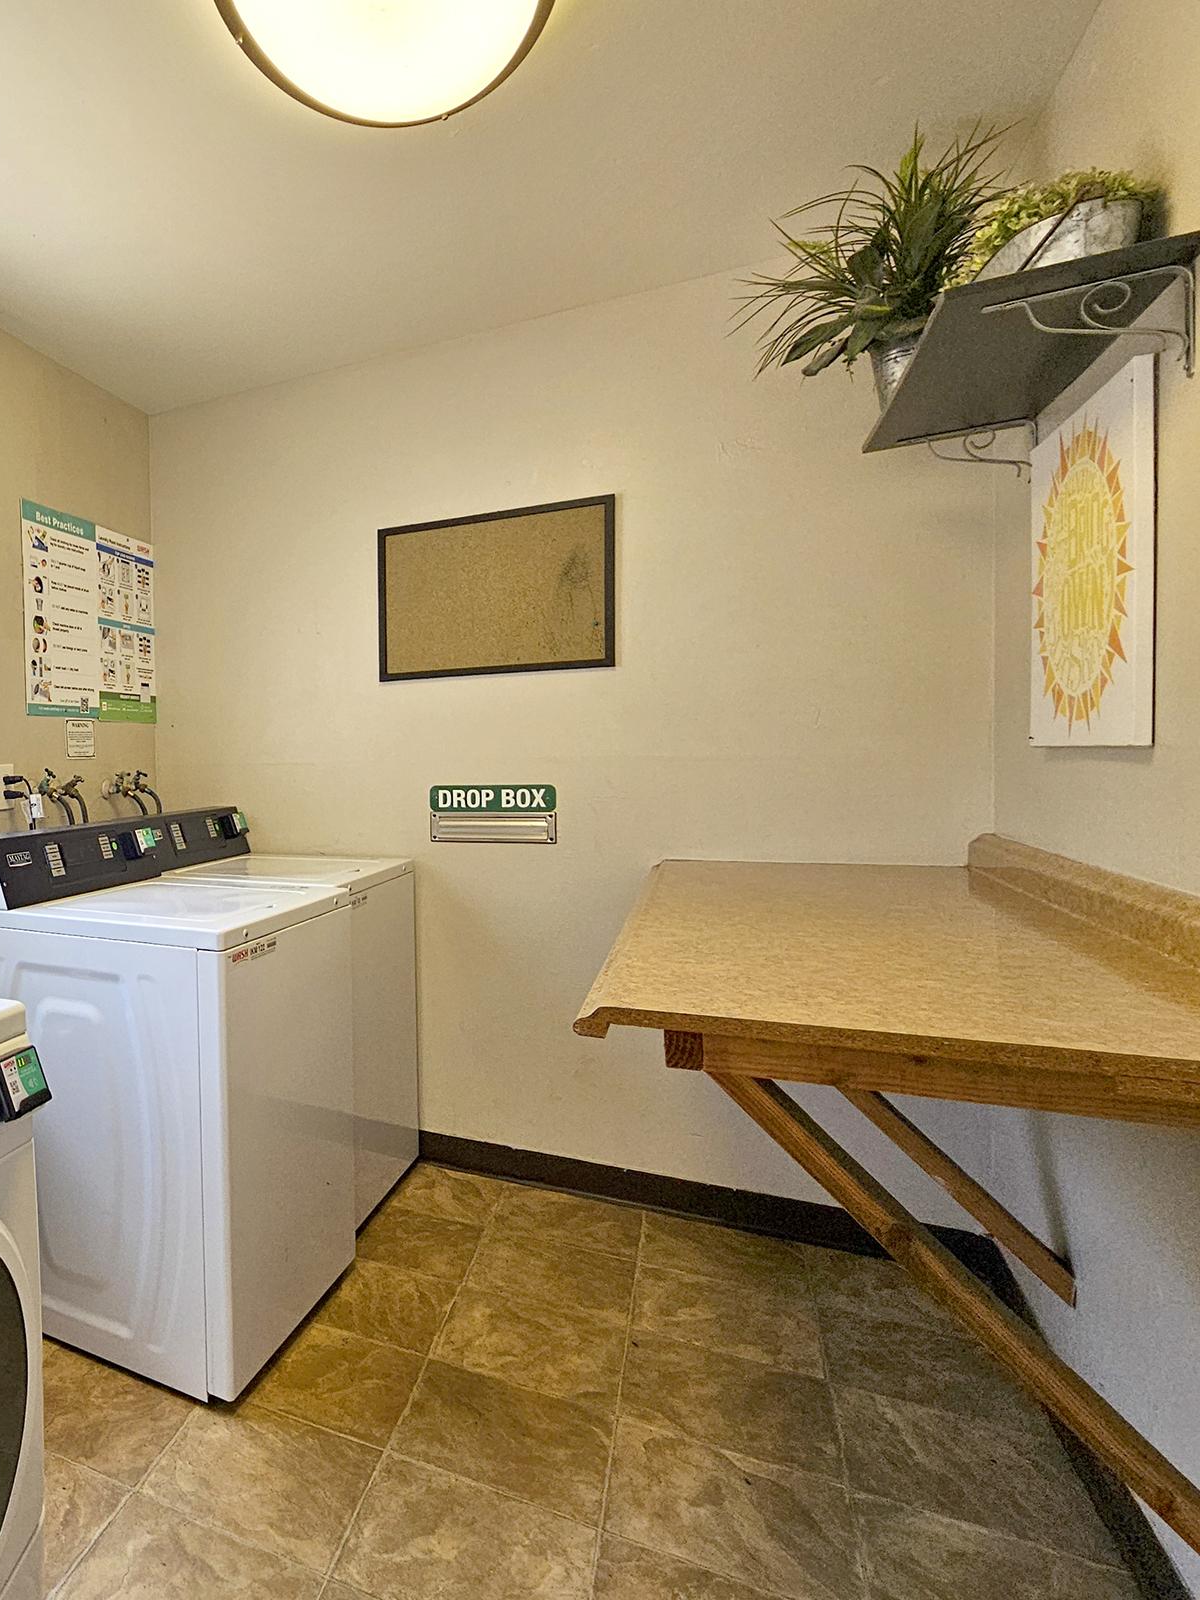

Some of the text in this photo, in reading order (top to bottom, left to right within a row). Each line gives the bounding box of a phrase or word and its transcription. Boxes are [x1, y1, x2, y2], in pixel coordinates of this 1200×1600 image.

[35, 511, 84, 536] Best Practices
[438, 788, 547, 808] DROP BOX
